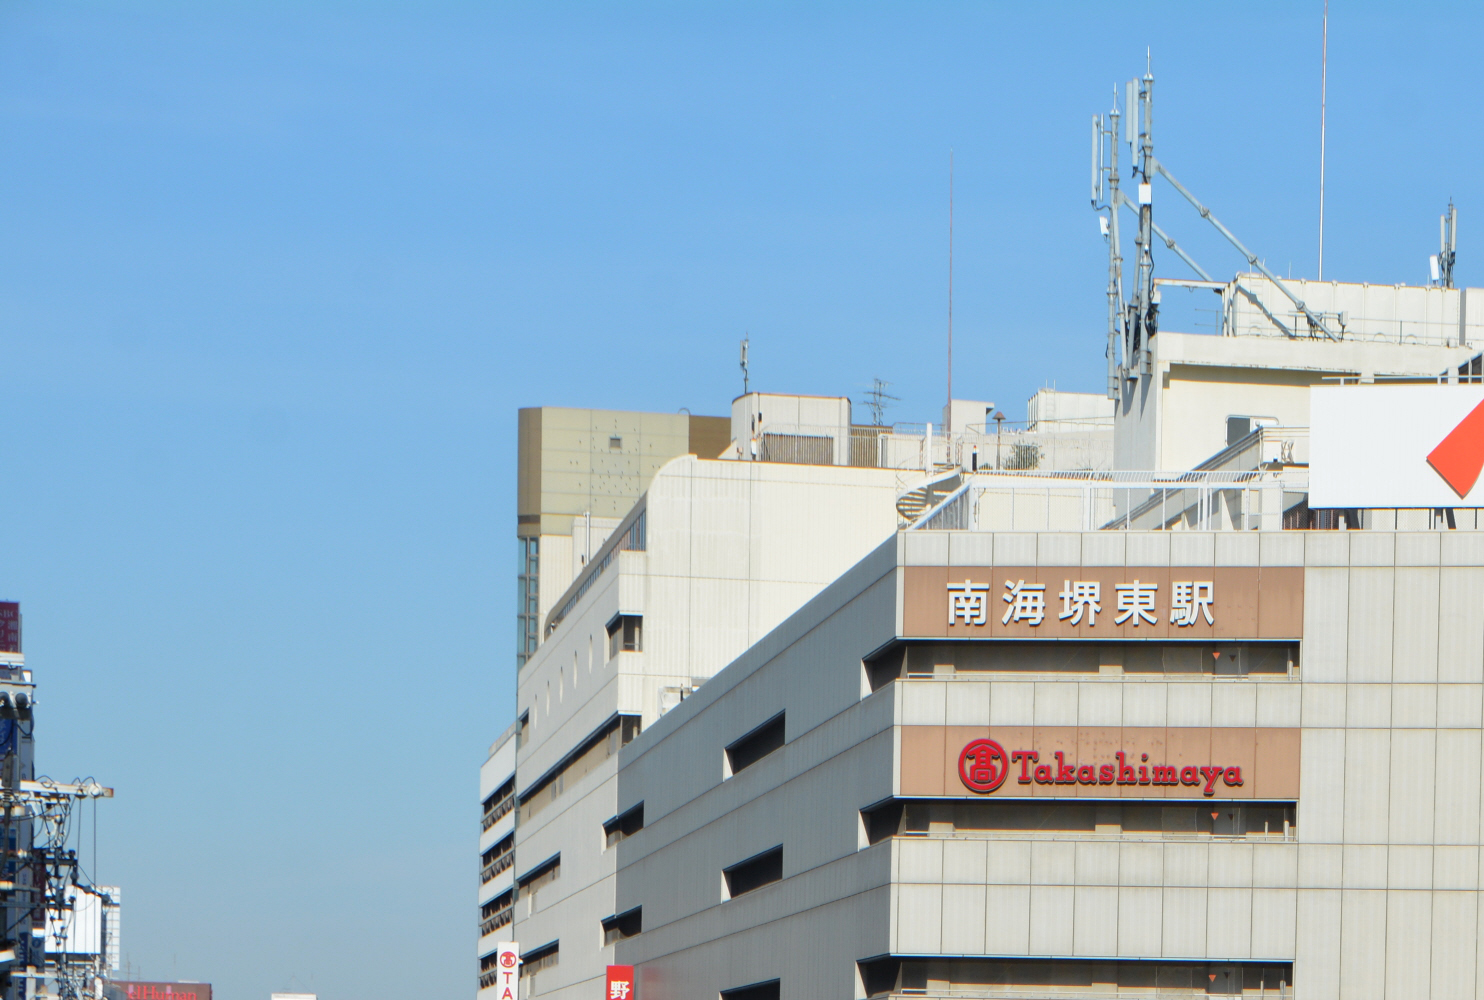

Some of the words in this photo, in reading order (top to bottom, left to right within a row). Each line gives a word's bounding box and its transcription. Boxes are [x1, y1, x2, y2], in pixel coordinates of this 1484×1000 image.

[946, 579, 1214, 626] 南海堺東駅
[1012, 751, 1243, 795] Takashimaya
